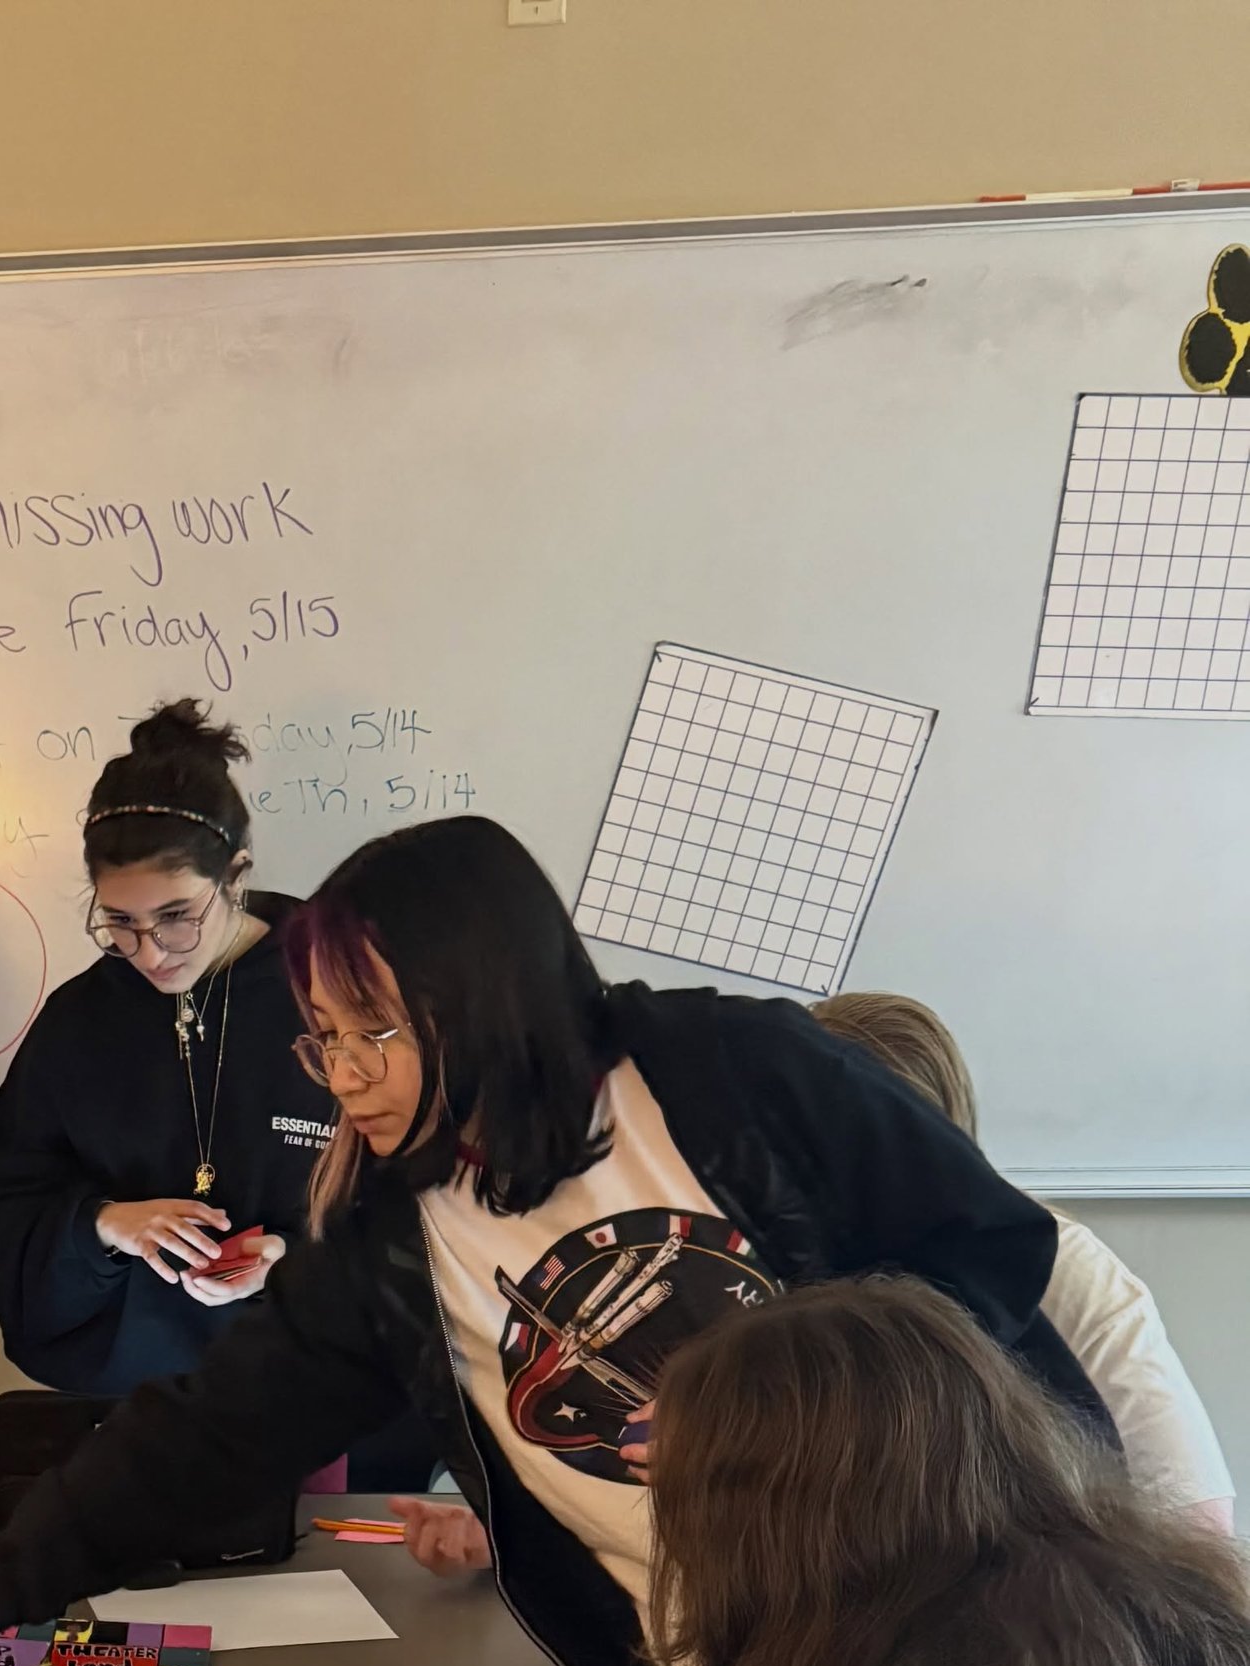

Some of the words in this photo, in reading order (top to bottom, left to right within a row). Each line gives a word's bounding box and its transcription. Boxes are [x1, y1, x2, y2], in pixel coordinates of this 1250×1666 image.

[172, 481, 313, 544] work
[37, 726, 96, 761] on
[284, 1134, 303, 1147] FEAR
[304, 1137, 313, 1148] OF
